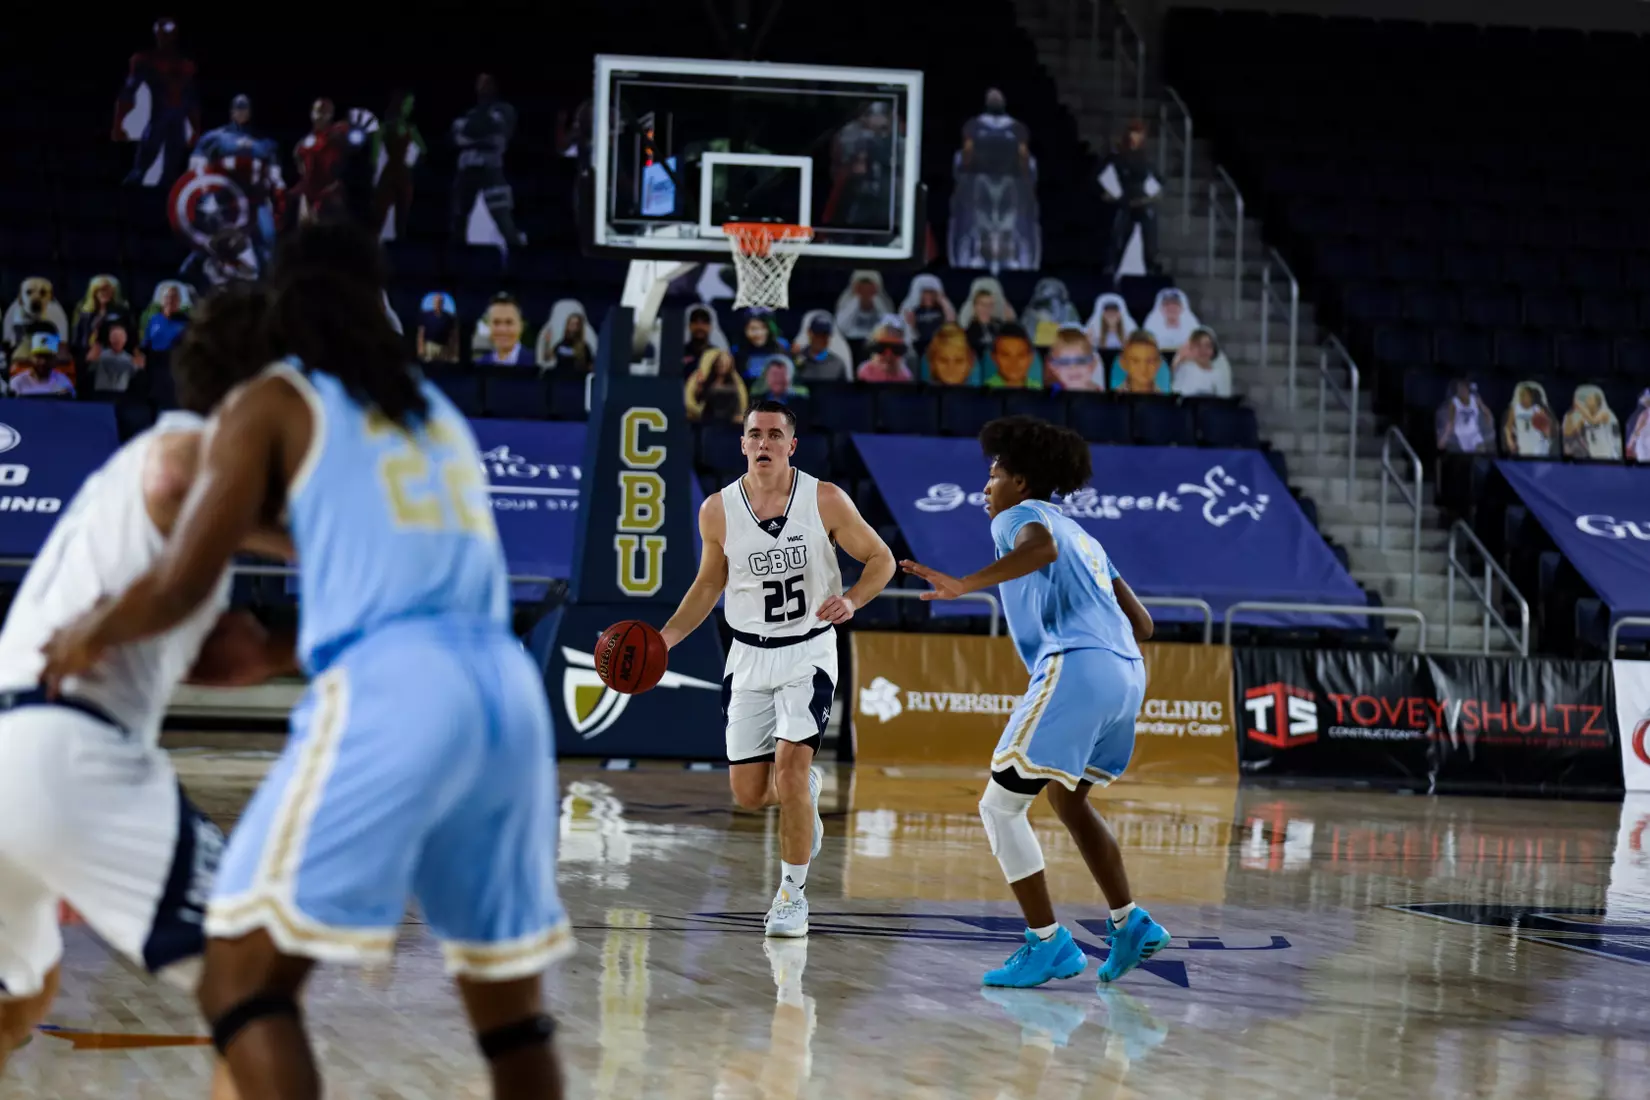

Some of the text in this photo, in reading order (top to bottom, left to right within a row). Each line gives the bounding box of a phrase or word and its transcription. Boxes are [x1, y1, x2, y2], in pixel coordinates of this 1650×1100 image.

[613, 406, 669, 597] CBU
[787, 534, 804, 543] WAC
[748, 545, 808, 577] CBU
[762, 573, 807, 623] 25
[1144, 698, 1222, 721] CLINIC
